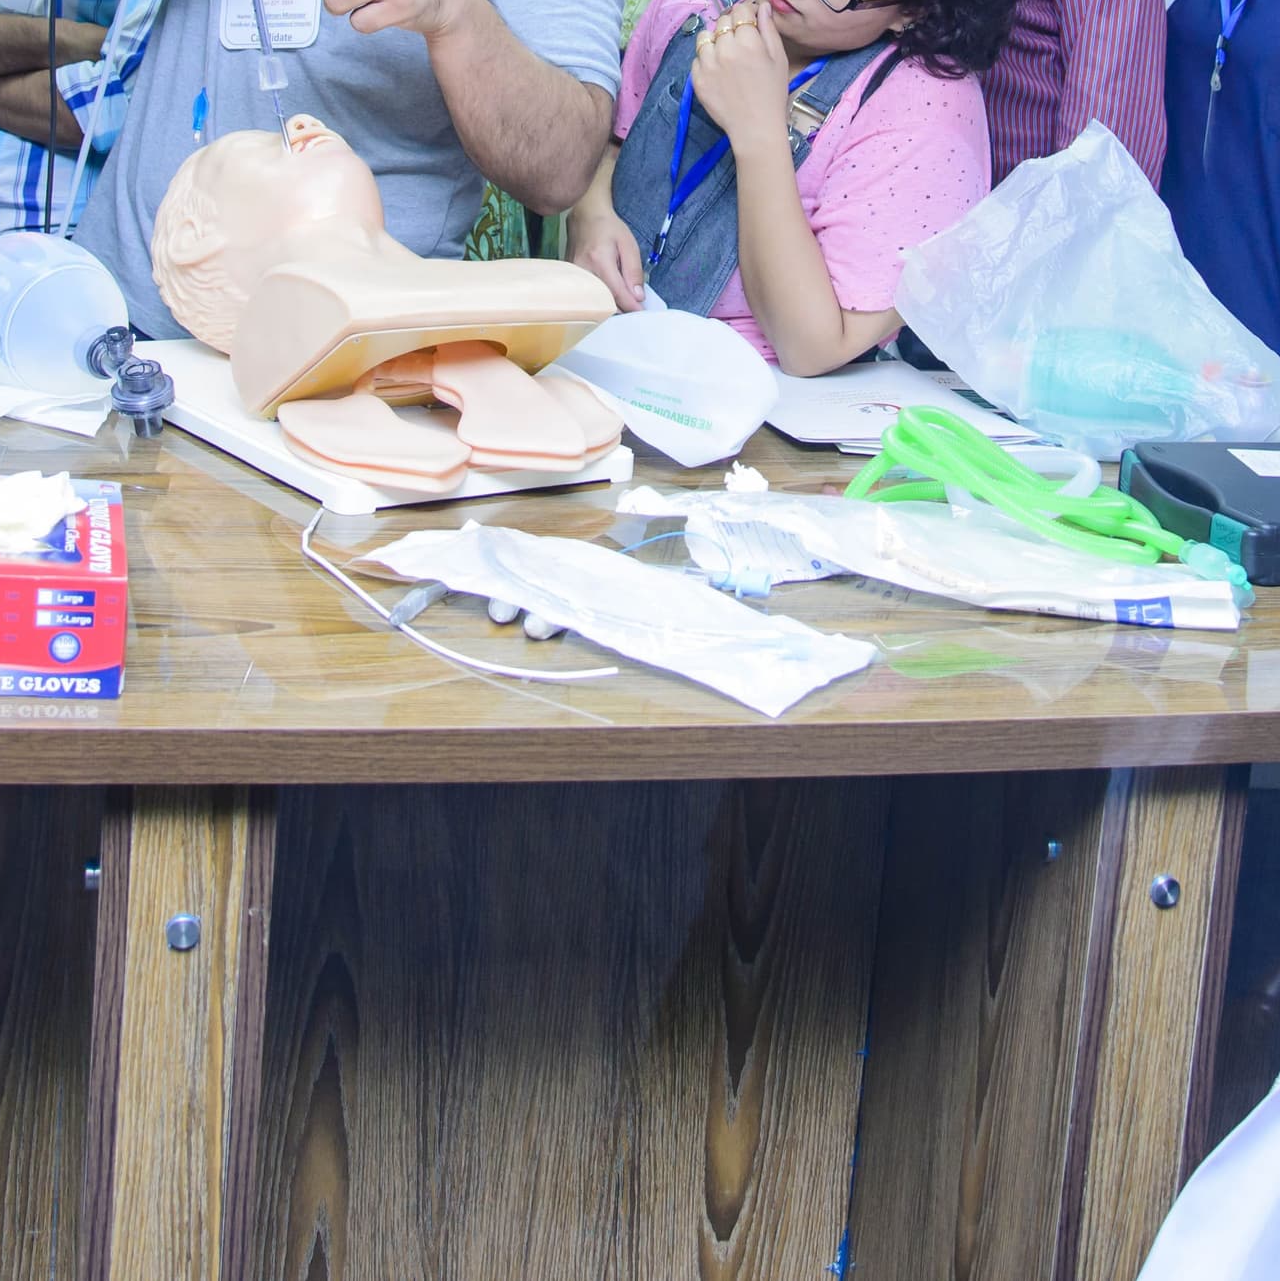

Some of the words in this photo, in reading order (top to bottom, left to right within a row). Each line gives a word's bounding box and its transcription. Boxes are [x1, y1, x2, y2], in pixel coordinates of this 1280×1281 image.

[250, 32, 293, 42] Caidate
[56, 594, 84, 605] Large
[56, 615, 92, 626] X-Large
[19, 675, 102, 694] GLOVES
